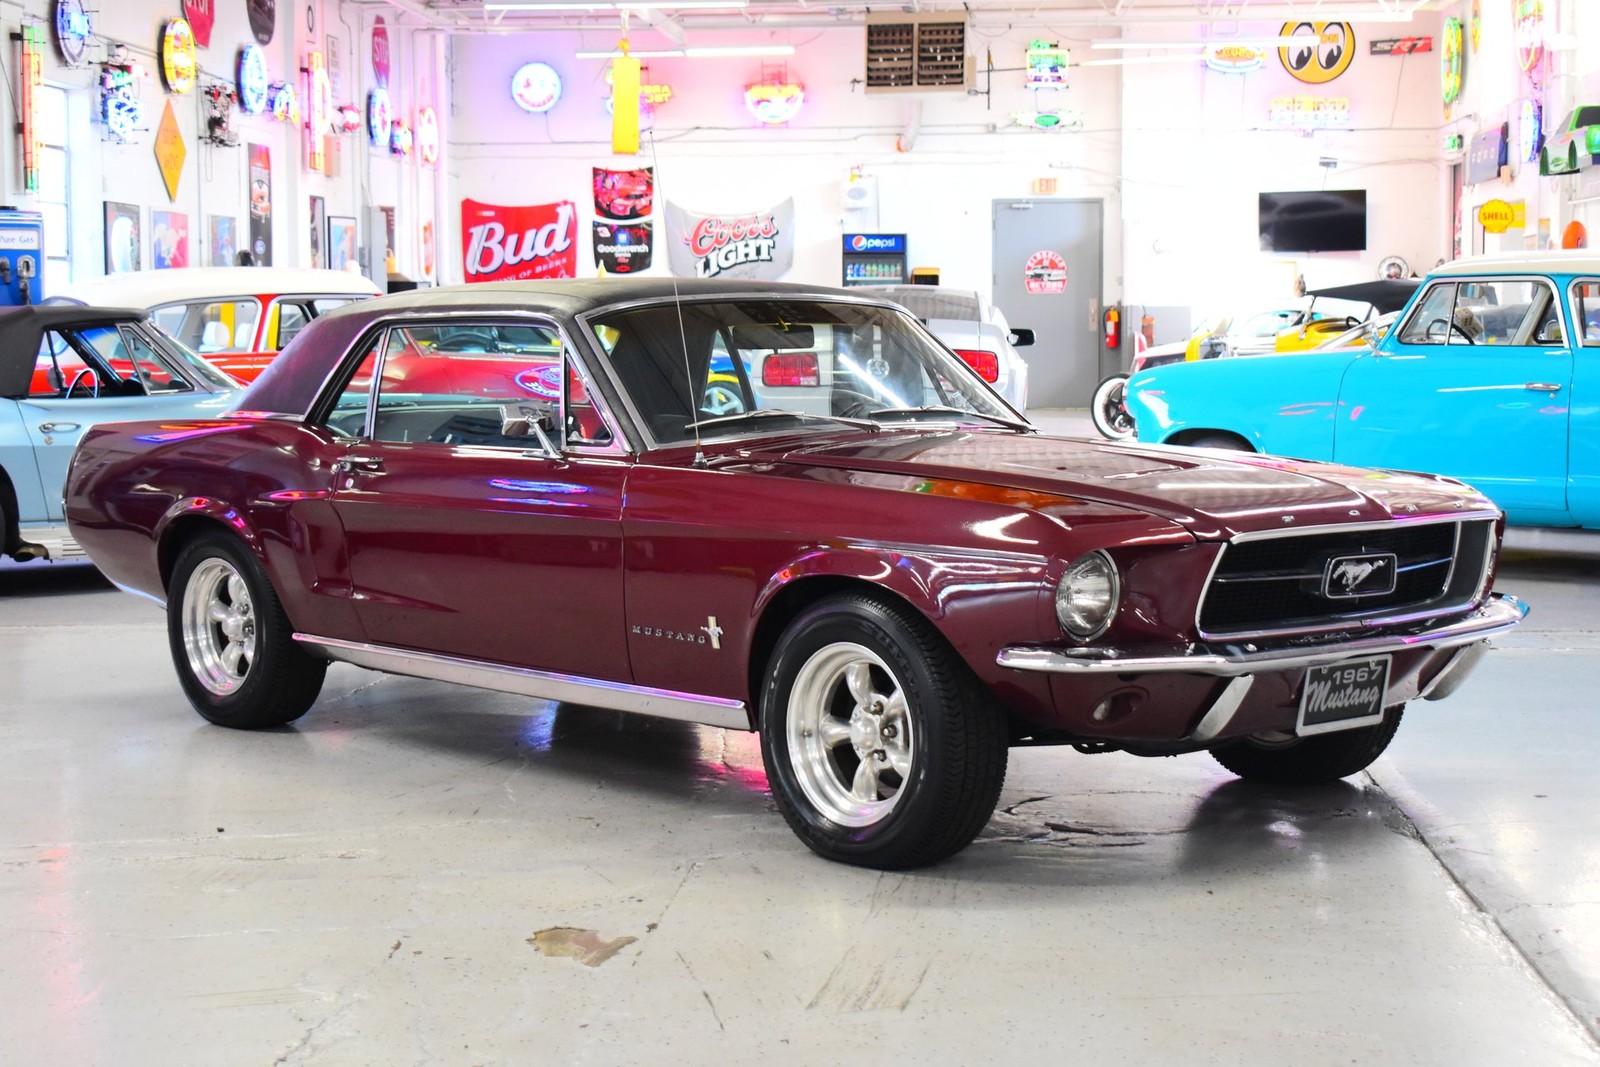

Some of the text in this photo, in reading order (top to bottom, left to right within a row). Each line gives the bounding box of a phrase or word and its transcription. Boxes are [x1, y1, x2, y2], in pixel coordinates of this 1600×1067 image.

[1372, 40, 1429, 51] SRT
[1039, 177, 1057, 193] EXIT
[1482, 211, 1509, 221] SHELL
[465, 203, 571, 276] Bud
[684, 214, 777, 257] Coors
[867, 237, 895, 249] pepsi
[596, 243, 649, 253] Goodwrench
[535, 257, 568, 274] BEERS
[696, 238, 774, 278] LIGHT
[631, 624, 706, 644] MUSTANG
[1332, 665, 1382, 685] 1967
[1307, 679, 1379, 713] Mustang
